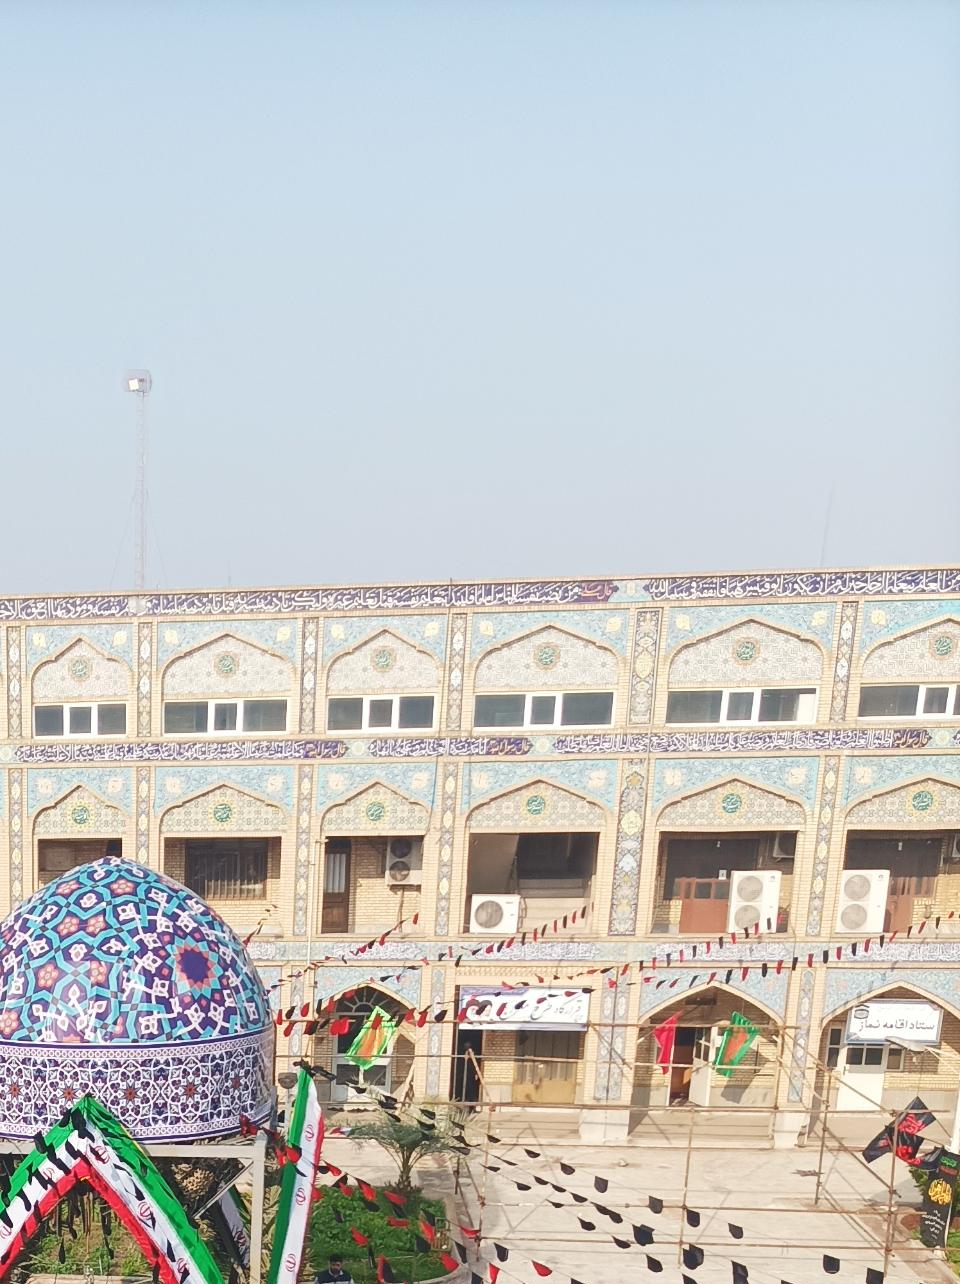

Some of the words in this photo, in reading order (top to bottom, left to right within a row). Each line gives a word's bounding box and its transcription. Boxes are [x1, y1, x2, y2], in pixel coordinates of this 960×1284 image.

[859, 1019, 881, 1032] نماز
[883, 1018, 907, 1029] اقامه
[909, 1019, 935, 1030] ستاد
